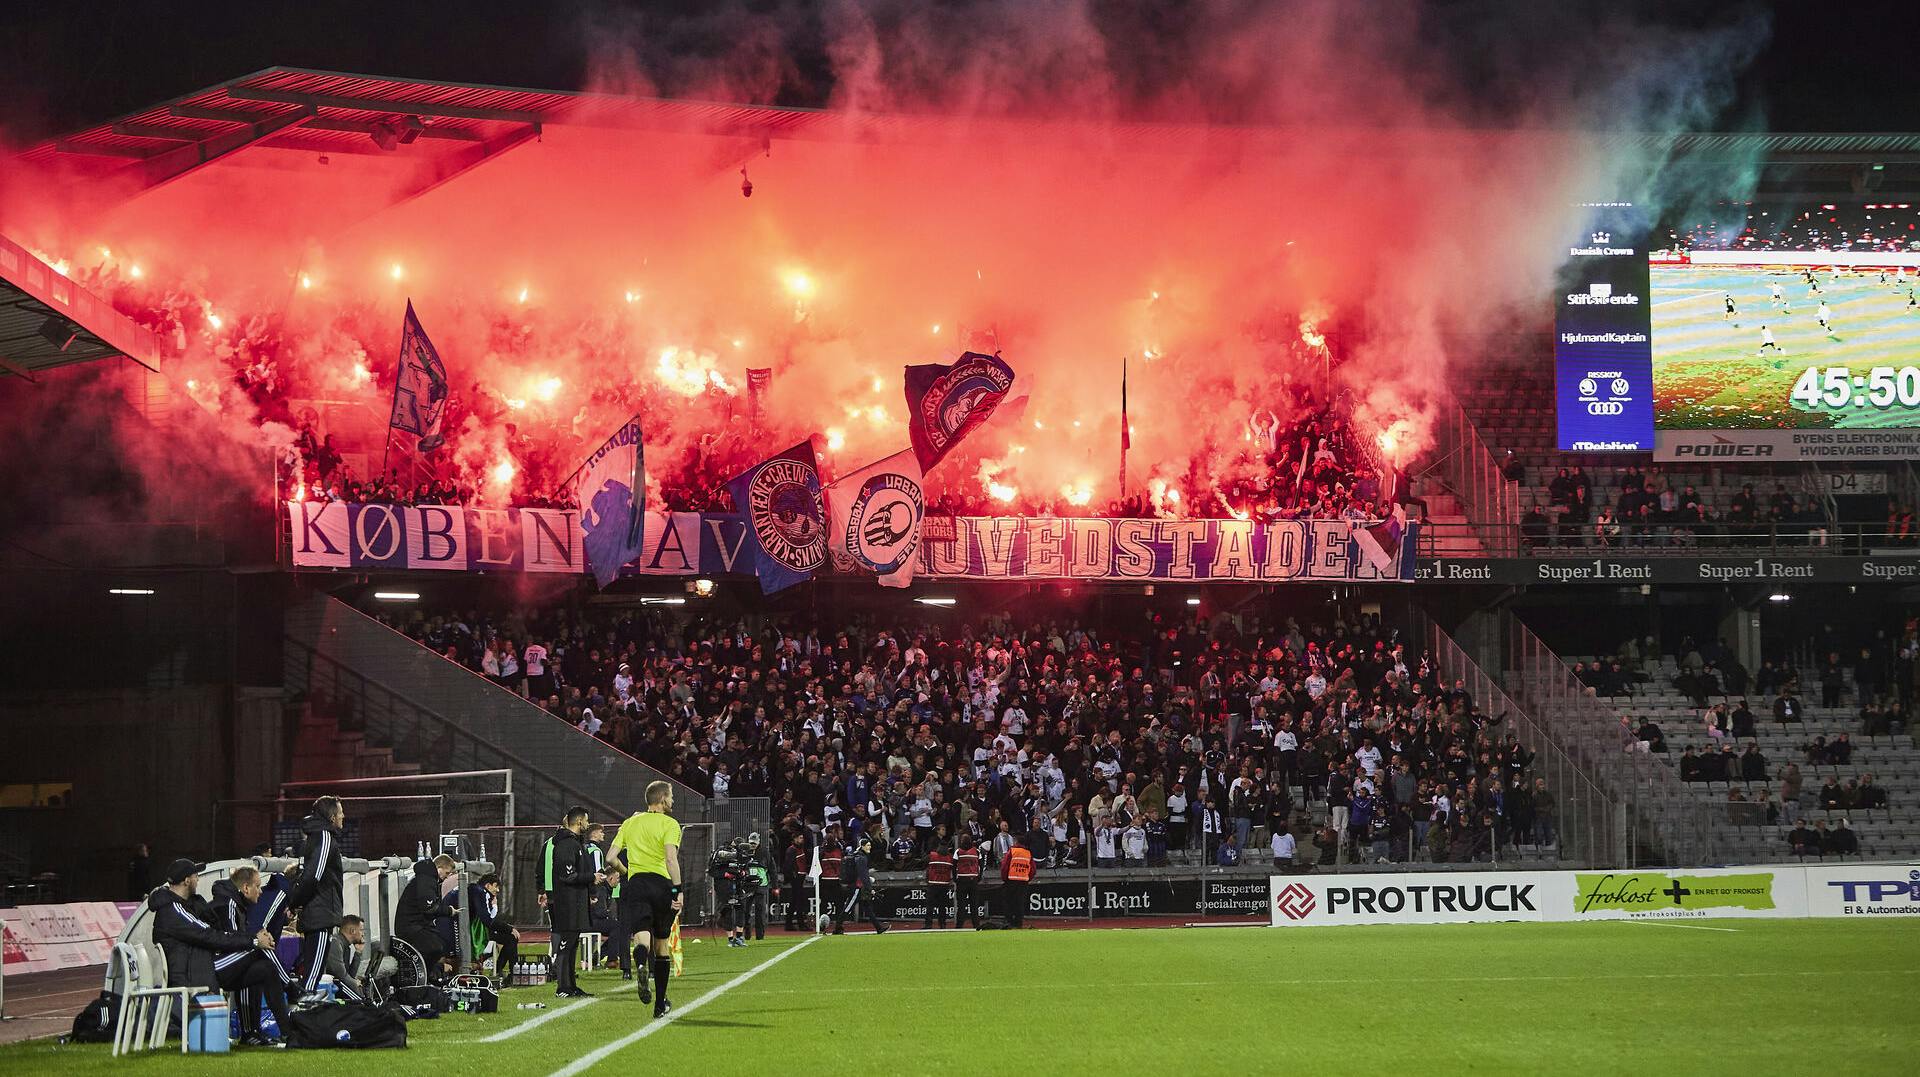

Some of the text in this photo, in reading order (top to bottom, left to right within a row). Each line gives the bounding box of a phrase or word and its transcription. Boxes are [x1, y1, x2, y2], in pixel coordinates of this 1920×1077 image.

[1570, 246, 1634, 256] Danish Crown
[1793, 366, 1920, 408] 45:50
[1793, 433, 1834, 444] BYENS
[1837, 433, 1913, 443] ELEKTRONIK
[1674, 444, 1774, 457] POWER
[1800, 445, 1919, 456] HVIDEVARER BUTIK
[1831, 472, 1857, 490] D4
[885, 476, 922, 507] URBAN
[918, 517, 1408, 579] OVEDSTADEN
[1432, 559, 1445, 579] 1
[1448, 564, 1491, 579] Rent
[1538, 559, 1652, 582] Super 1 Rent
[1699, 558, 1814, 581] Super 1 Rent
[1862, 562, 1917, 580] Super
[1029, 885, 1150, 915] Super 1 Rent
[1210, 883, 1266, 897] Eksperter
[1326, 884, 1537, 915] PROTRUCK
[1581, 874, 1658, 914] frokost
[1855, 905, 1864, 914] &
